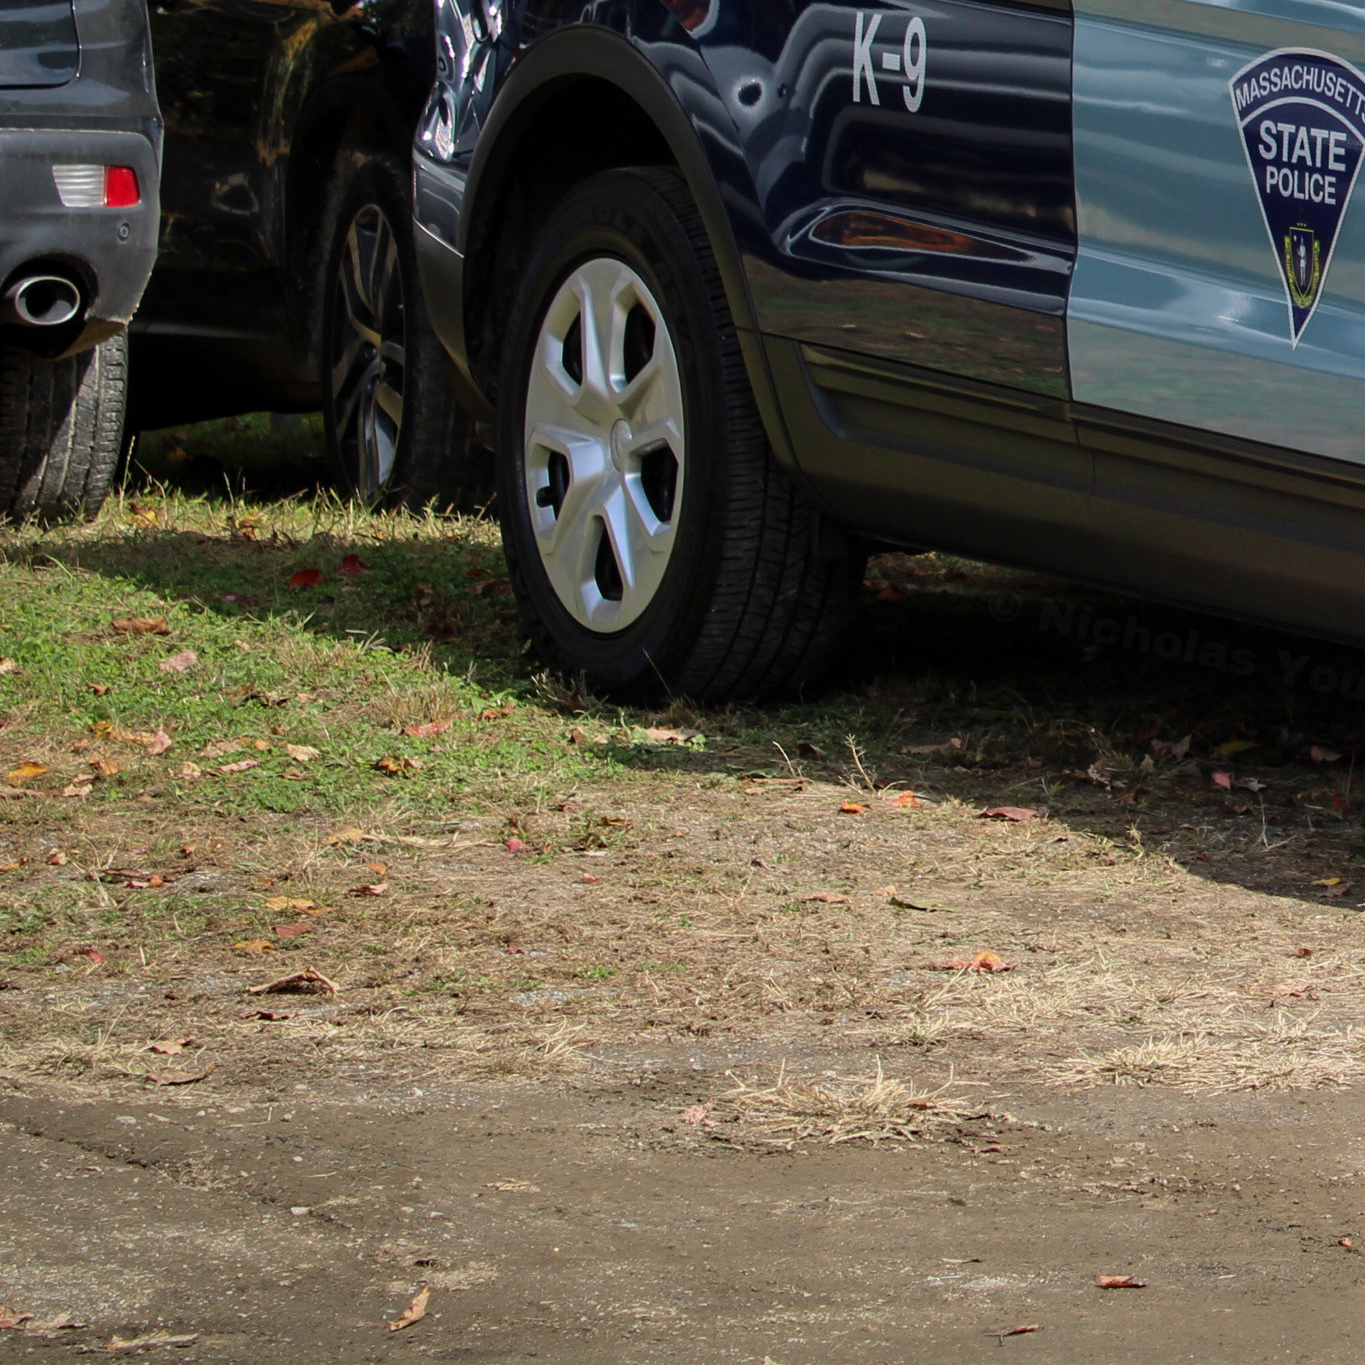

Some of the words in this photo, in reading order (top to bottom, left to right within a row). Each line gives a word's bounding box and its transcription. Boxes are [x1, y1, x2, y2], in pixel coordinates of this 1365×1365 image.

[851, 10, 928, 113] K-9
[1258, 119, 1348, 172] STATE
[1265, 165, 1337, 206] POLICE
